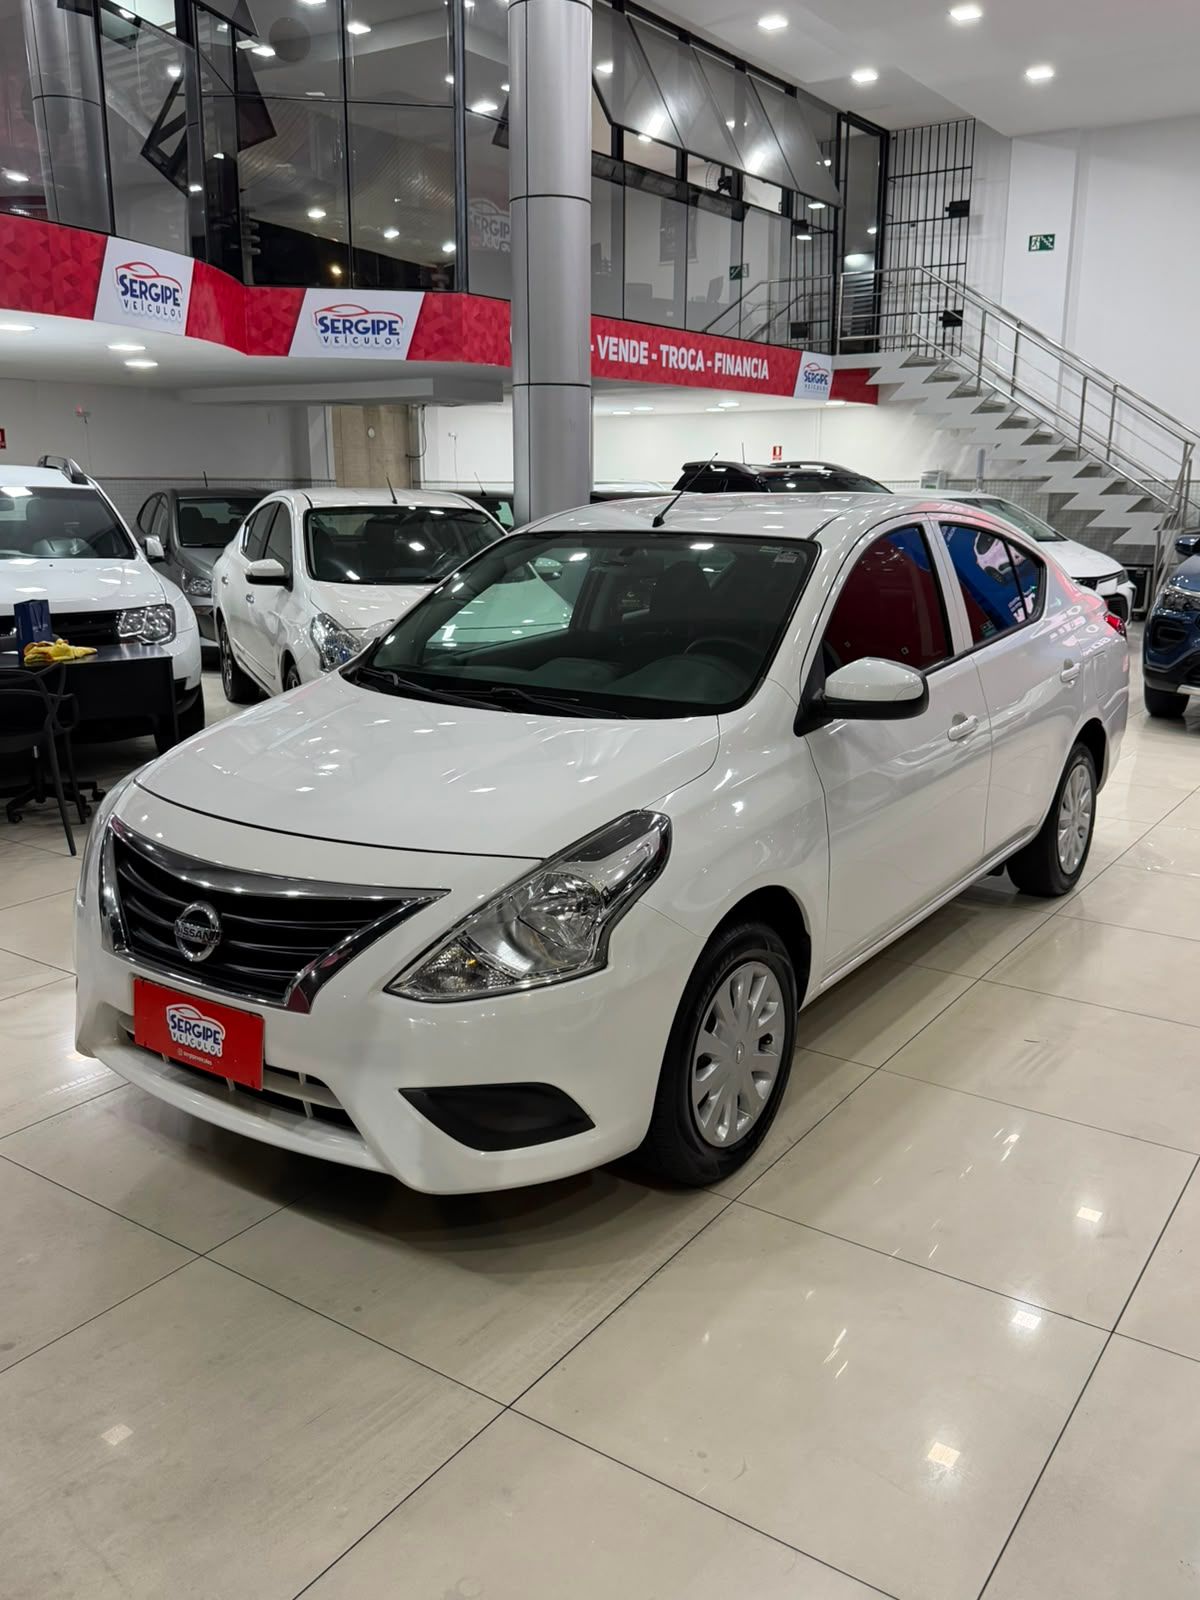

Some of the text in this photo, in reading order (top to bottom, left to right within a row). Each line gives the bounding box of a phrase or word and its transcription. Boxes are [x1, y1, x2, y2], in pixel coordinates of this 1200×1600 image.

[119, 274, 181, 307] SERGIPE
[318, 315, 400, 336] SERGIPE
[597, 335, 648, 365] VENDE
[660, 344, 704, 372] TROCA
[714, 352, 769, 380] FINANCIA
[170, 1014, 221, 1046] SERGIPE
